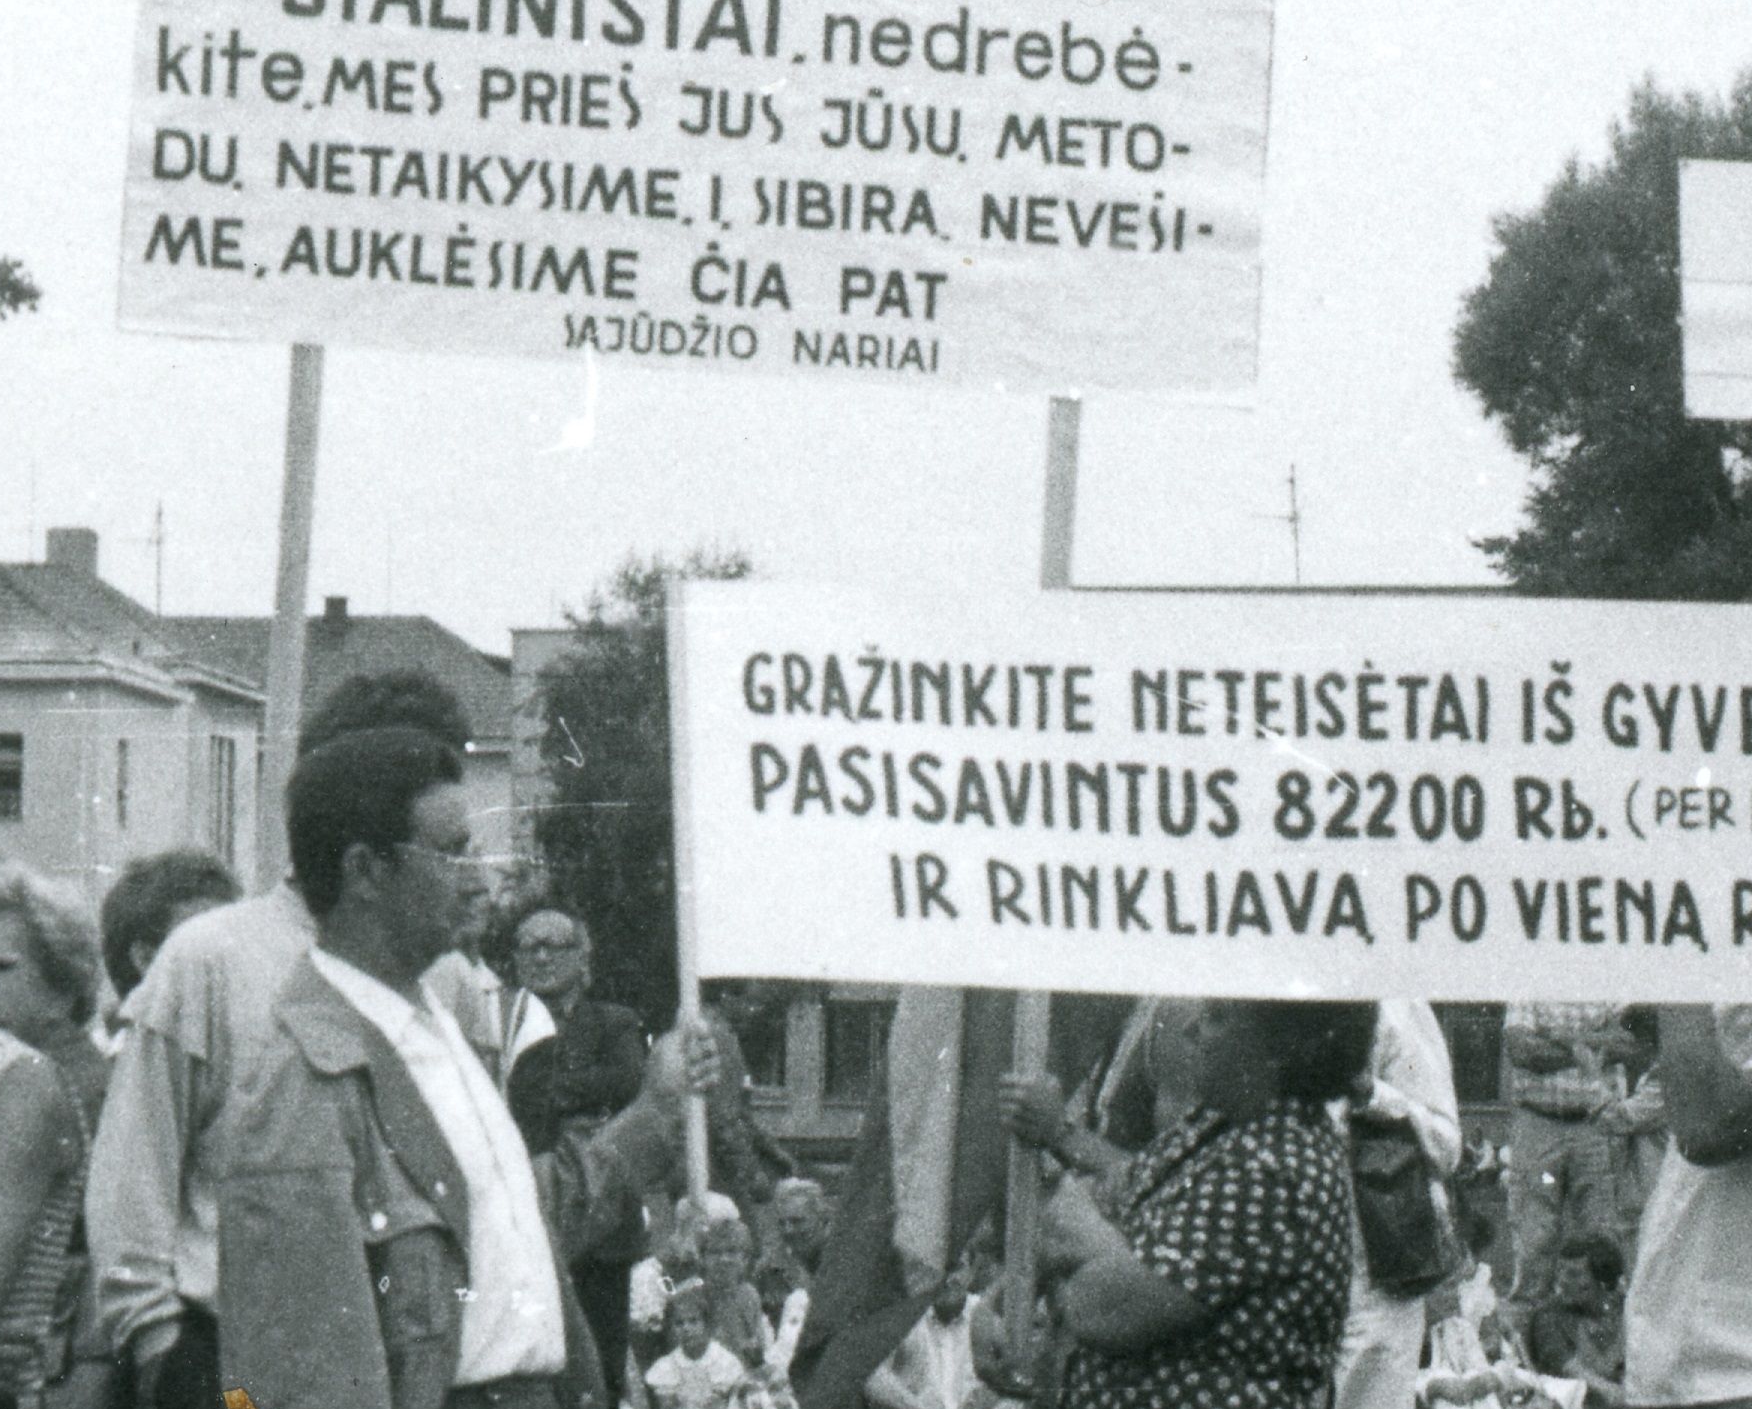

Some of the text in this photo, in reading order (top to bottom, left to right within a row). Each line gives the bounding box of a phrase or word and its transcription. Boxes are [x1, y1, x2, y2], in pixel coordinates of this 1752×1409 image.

[823, 7, 1192, 91] nedrebė-
[322, 56, 445, 117] MES
[479, 62, 642, 130] PRIEŠ
[679, 85, 784, 144] JUS
[995, 114, 1191, 173] METO-
[279, 224, 639, 300] AUKLĖSIME
[690, 241, 793, 312] ČIA
[841, 267, 949, 321] PAT
[793, 329, 941, 374] NARIAI
[1131, 659, 1489, 745] NETEISĖTAI
[1520, 659, 1575, 745] IŠ
[750, 741, 1240, 839] PASISAVINTUS
[1273, 770, 1486, 842] 82200
[1513, 776, 1609, 843] Rb.
[890, 851, 959, 919] IR
[986, 857, 1375, 944] RINKLIAVĄ
[1405, 872, 1489, 944] PO
[1511, 874, 1709, 954] VIENĄ
